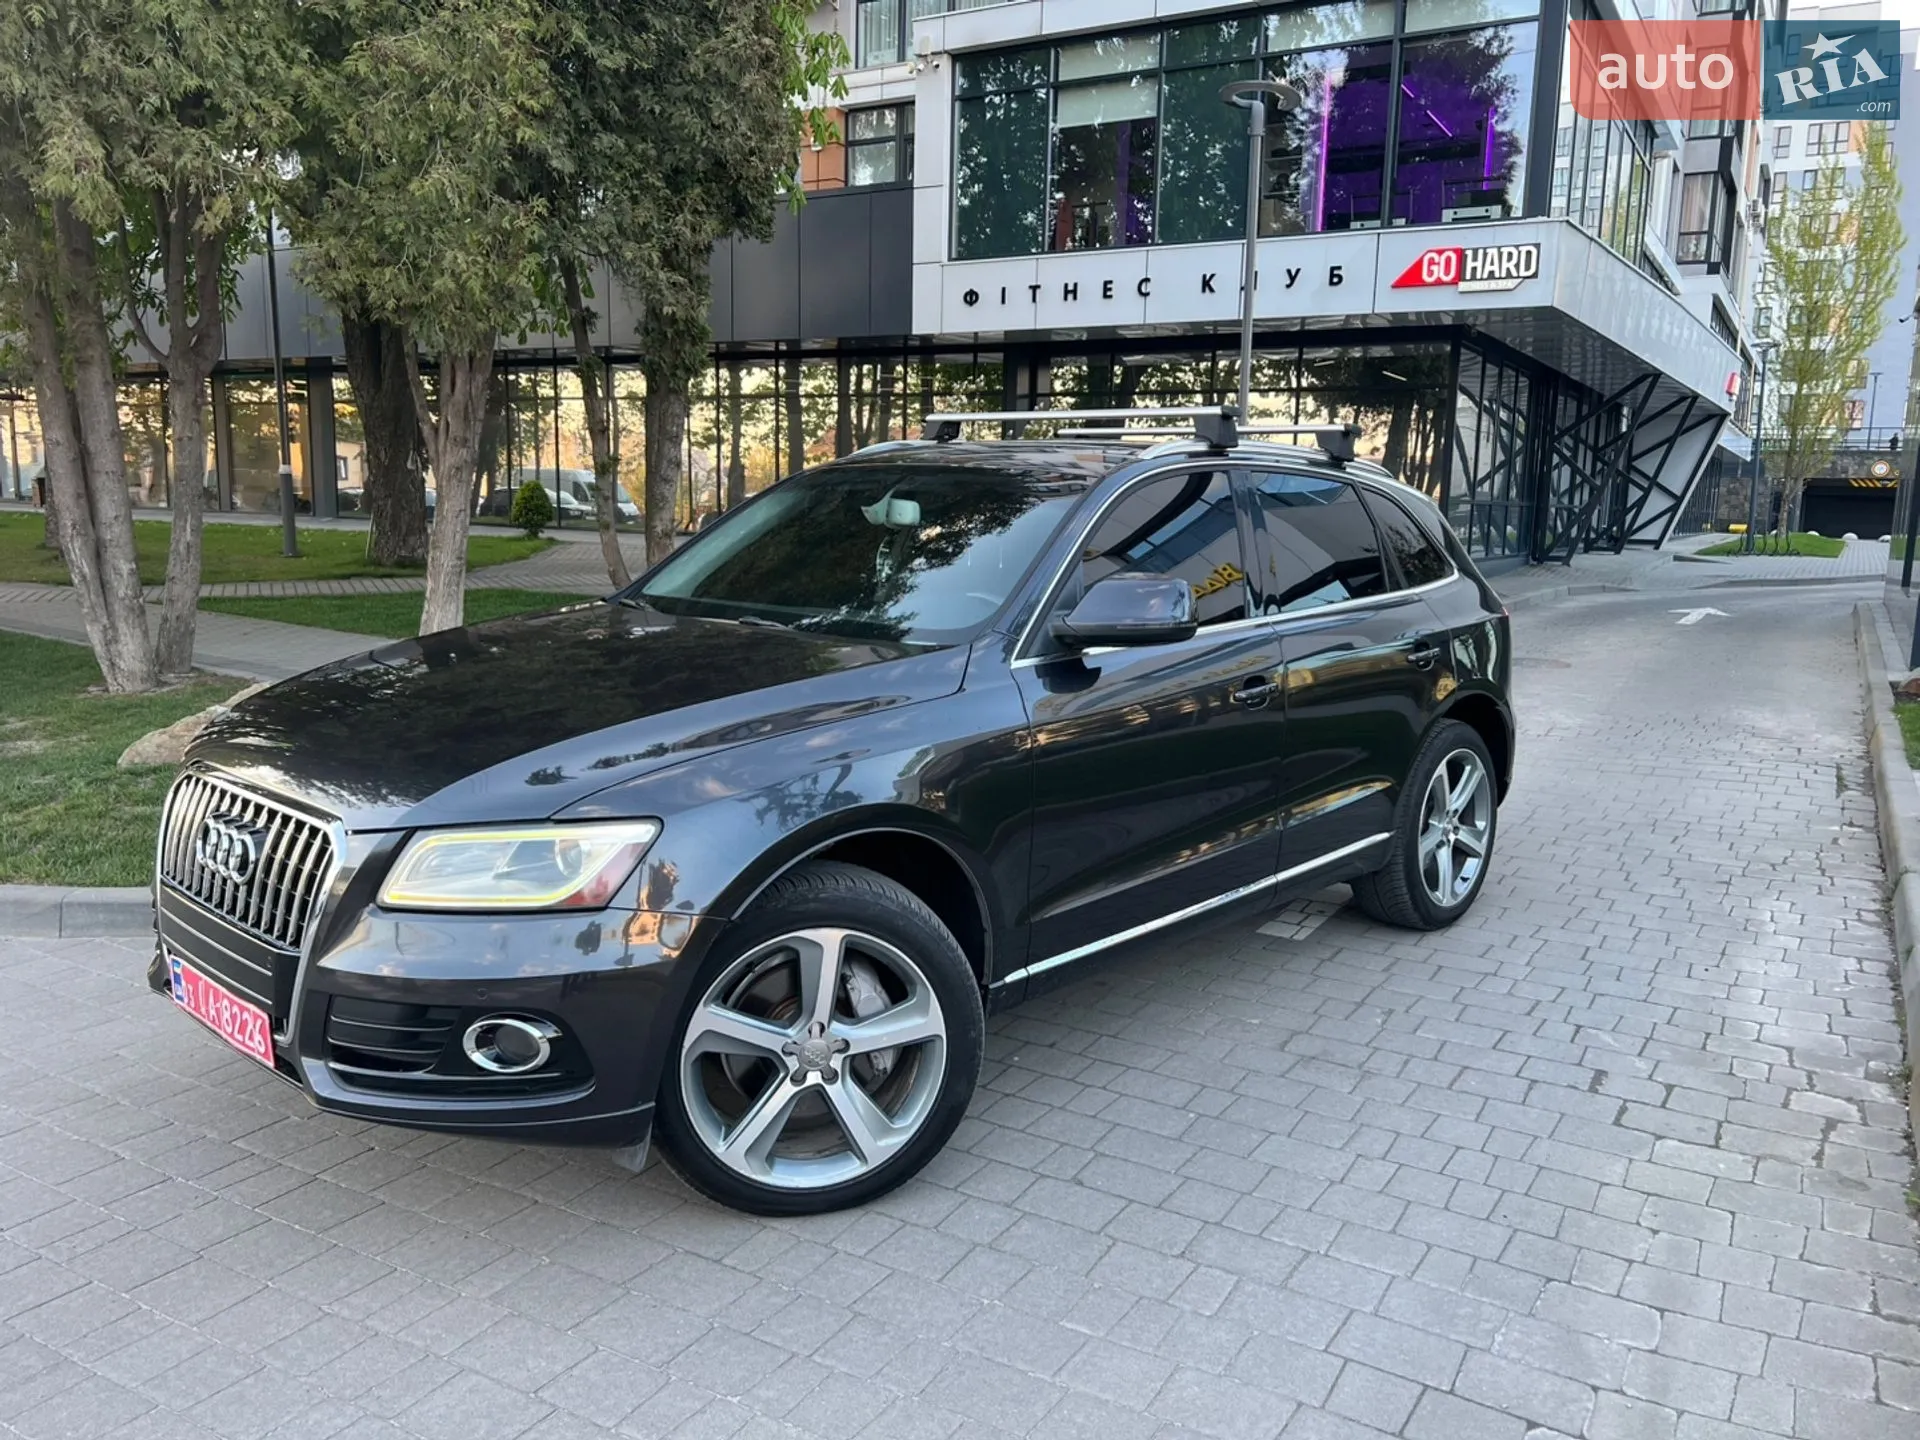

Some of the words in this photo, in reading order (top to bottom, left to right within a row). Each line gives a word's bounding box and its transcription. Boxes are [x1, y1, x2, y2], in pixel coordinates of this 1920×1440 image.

[1421, 250, 1458, 283] GO
[1464, 244, 1538, 280] HARD
[962, 277, 1151, 307] ФІТНЕС
